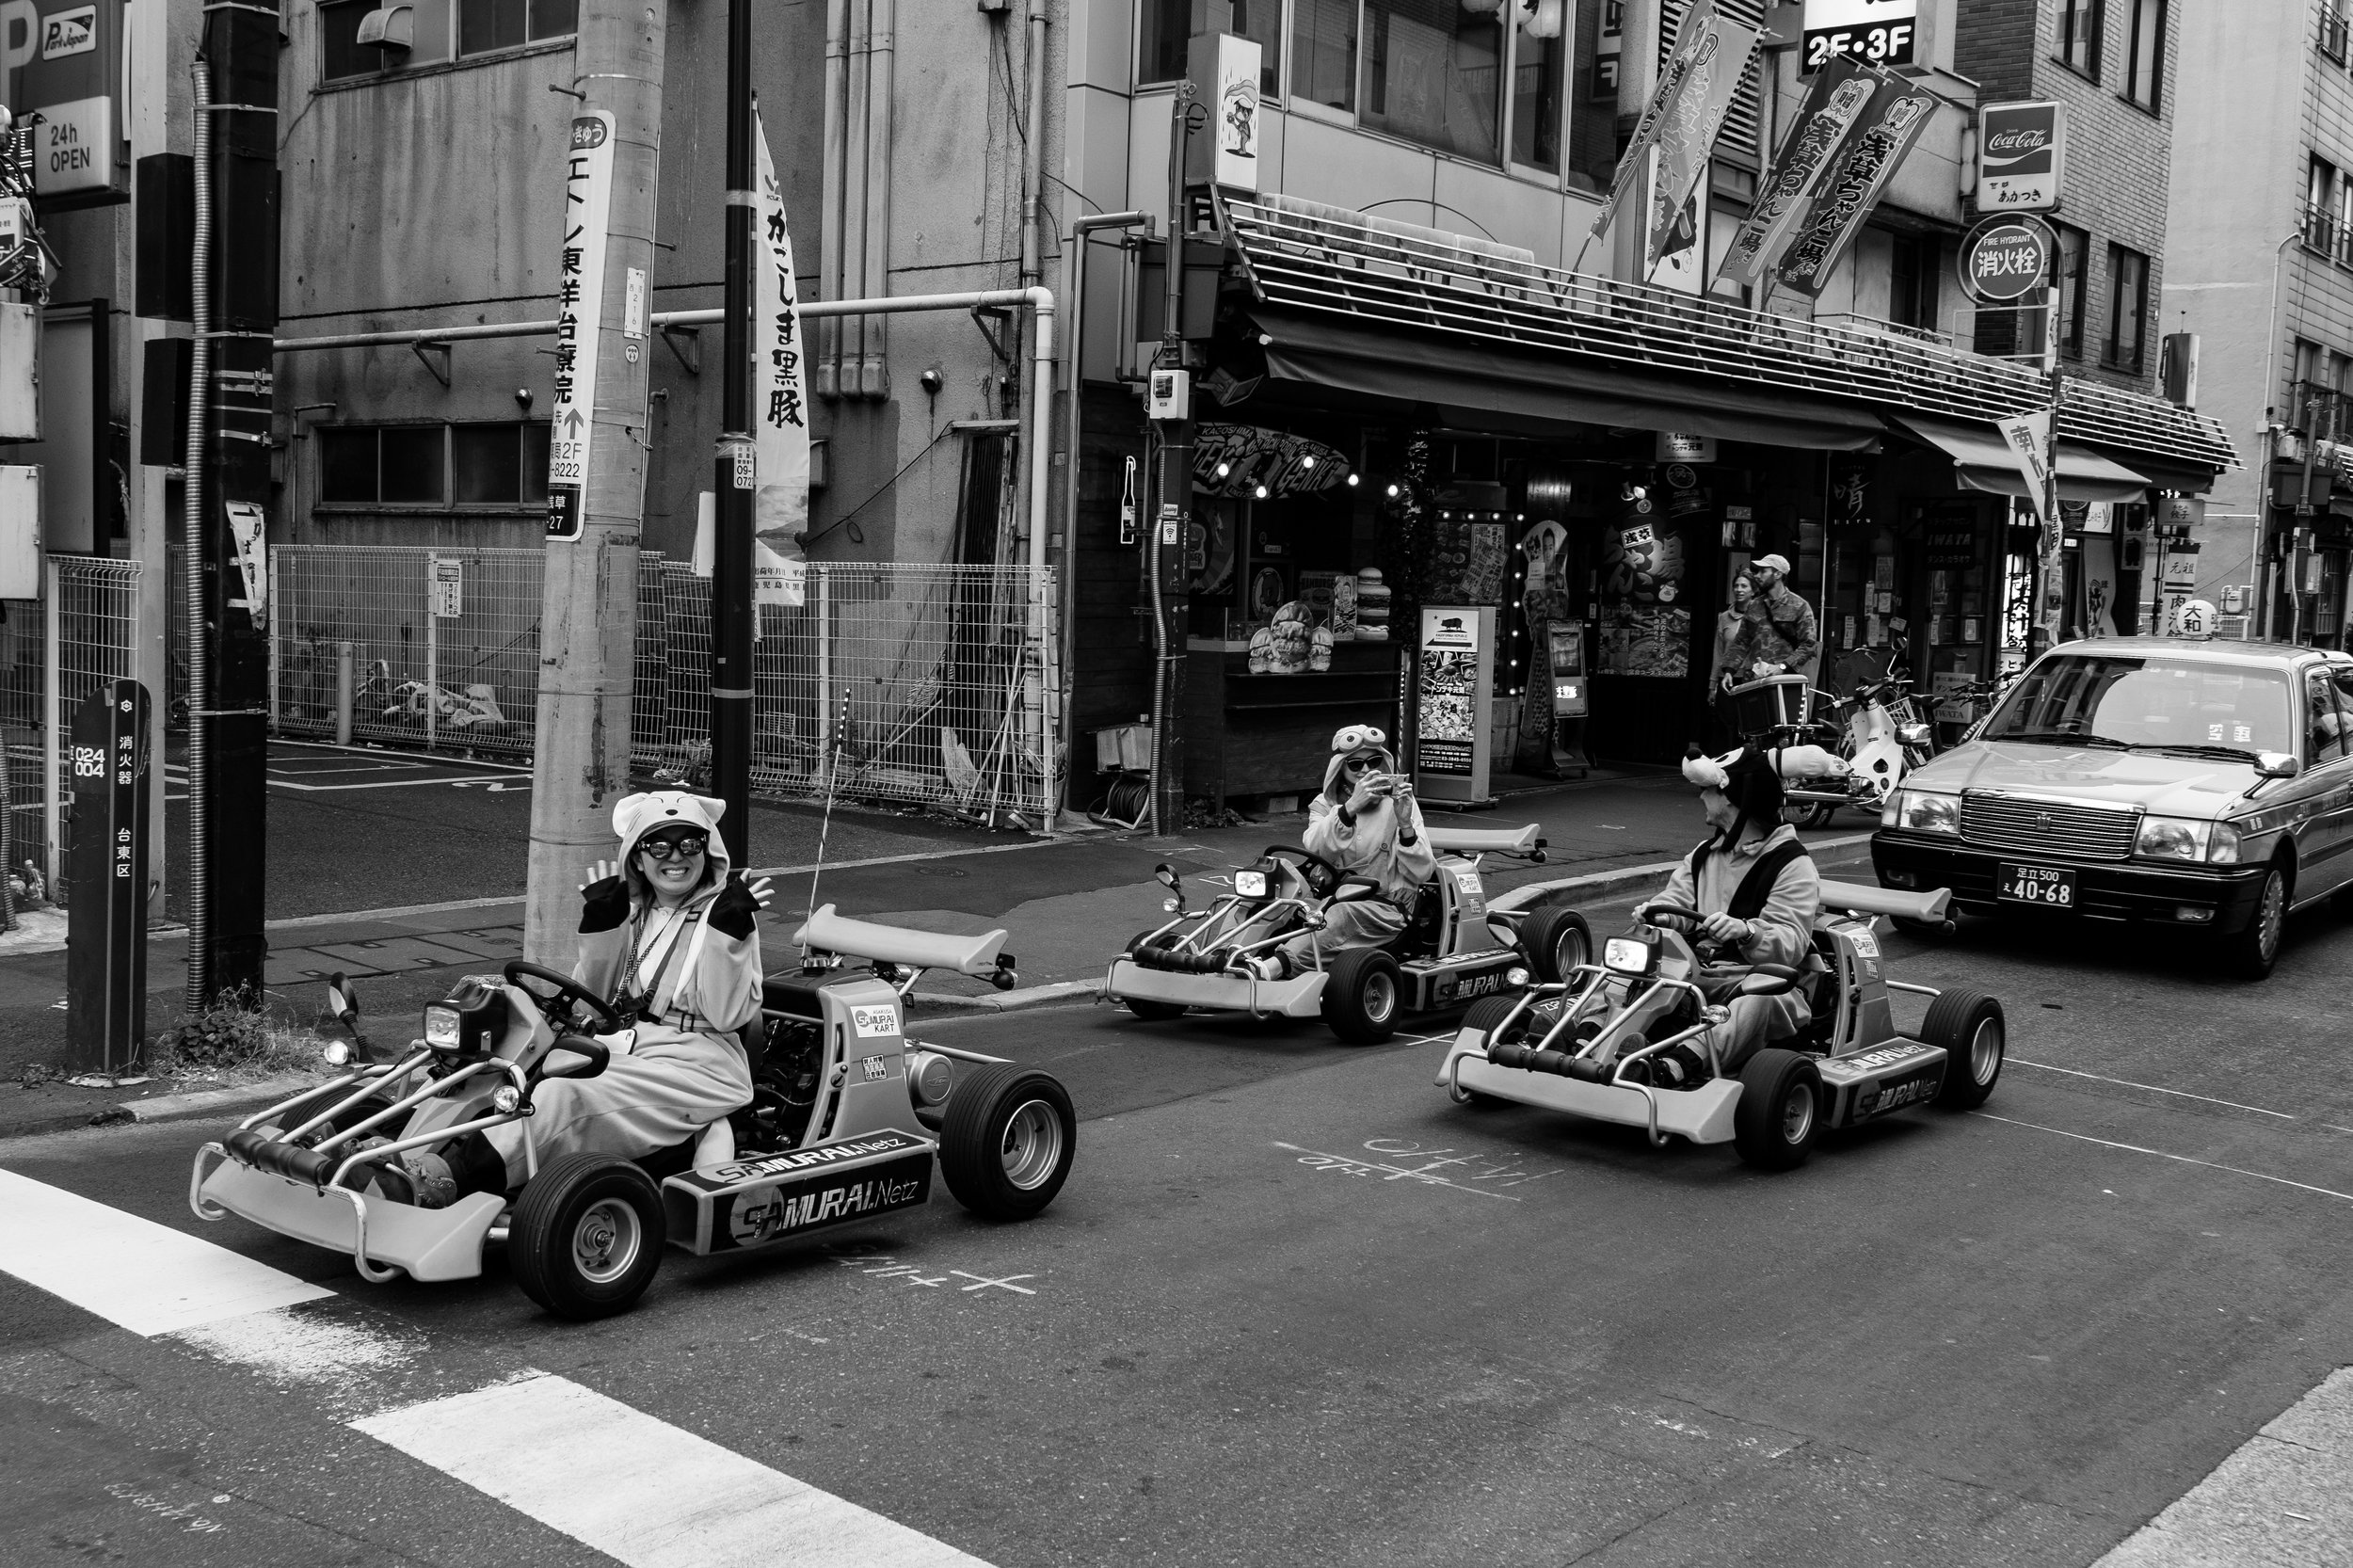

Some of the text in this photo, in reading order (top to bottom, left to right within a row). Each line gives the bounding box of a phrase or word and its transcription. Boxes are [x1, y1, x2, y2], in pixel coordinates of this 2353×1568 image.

[51, 124, 77, 147] 24h
[1988, 128, 2049, 151] Coca-Cola
[51, 147, 90, 173] OPEN
[1998, 188, 2041, 203] あかつき
[1983, 234, 2031, 248] FIRE HYDRANT
[1977, 246, 2038, 278] 消火栓
[766, 208, 804, 429] かごしま黒豚
[1202, 425, 1255, 439] KAGOSHIMA
[737, 476, 754, 486] 072
[1832, 472, 1873, 518] 晴
[1928, 533, 1971, 546] IWATA
[2169, 562, 2195, 575] 元祖
[2184, 604, 2202, 632] 大和
[75, 746, 105, 763] 024
[118, 735, 134, 785] 消火器
[75, 761, 105, 778] 004
[116, 827, 132, 877] 台東区
[2003, 882, 2011, 892] え
[2013, 879, 2071, 904] 40-68
[874, 1024, 895, 1033] KART
[715, 1137, 907, 1183] SAMURAI.Netz
[735, 1177, 920, 1240] SAMURAI.Netz
